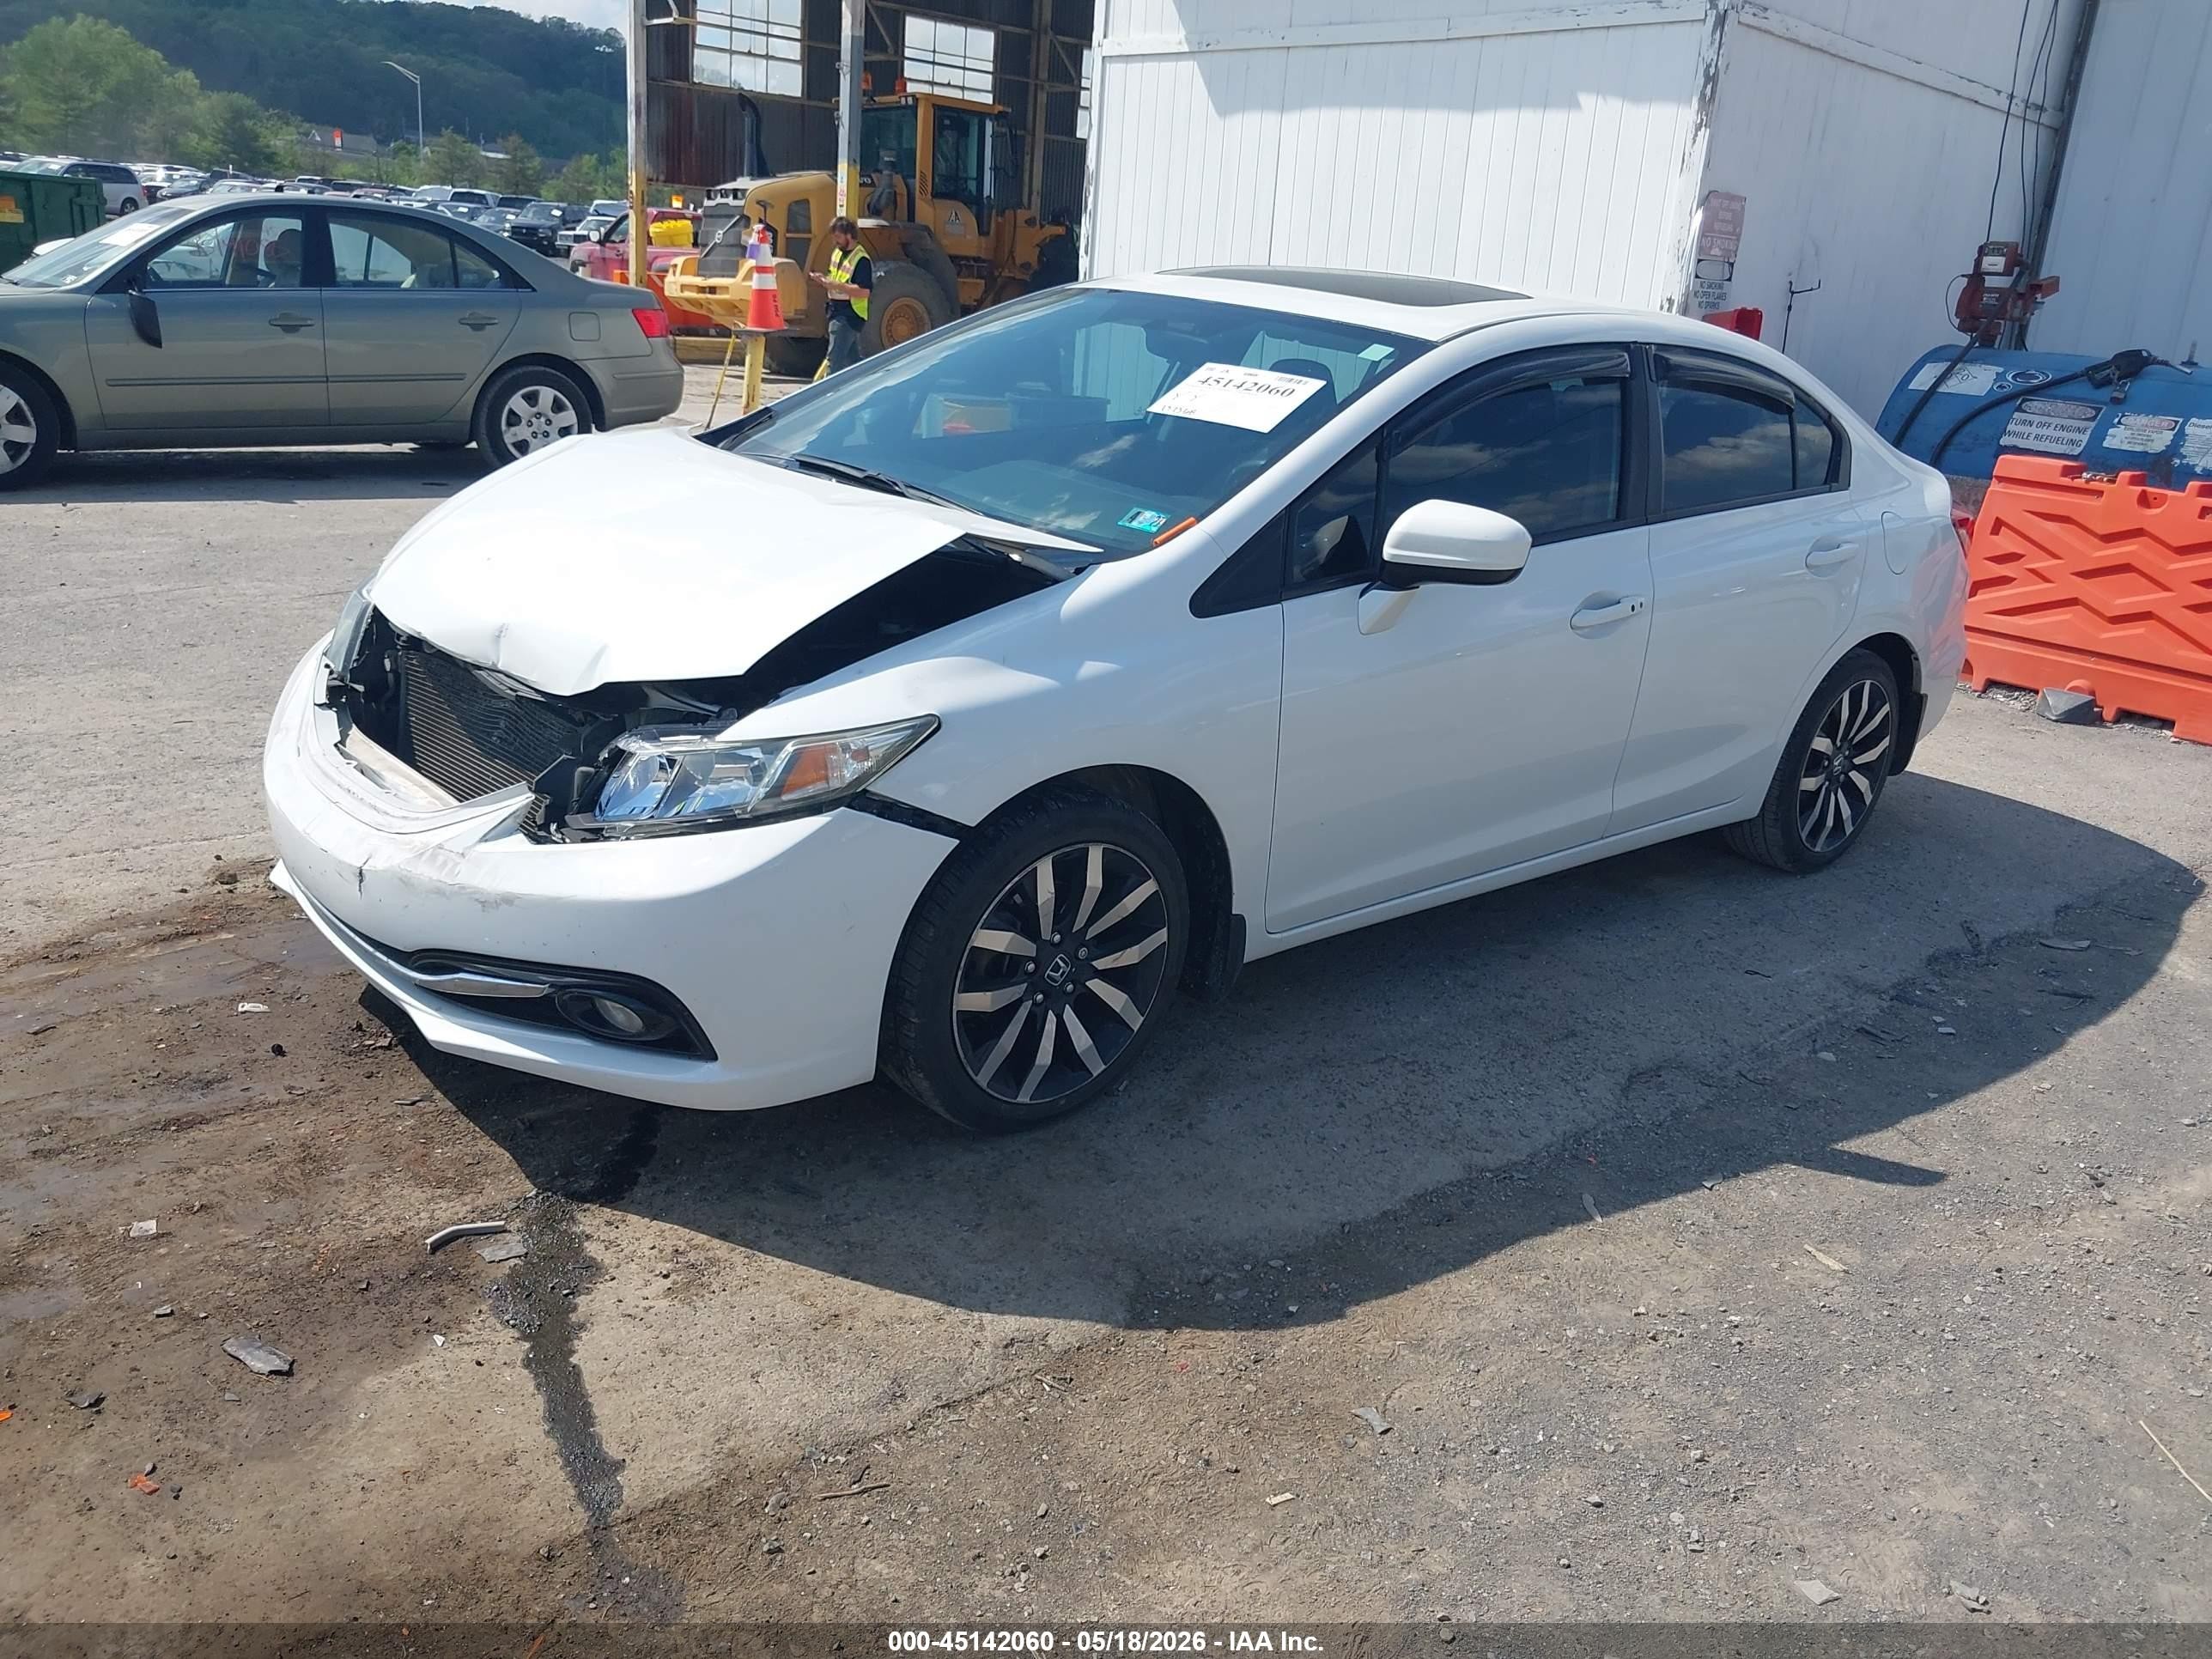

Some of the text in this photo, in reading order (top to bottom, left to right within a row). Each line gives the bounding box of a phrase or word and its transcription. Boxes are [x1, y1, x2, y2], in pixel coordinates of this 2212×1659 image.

[1197, 375, 1296, 398] 45142060
[2009, 417, 2089, 436] TURN OFF ENGINE
[2004, 429, 2083, 447] WHILE REFUELING
